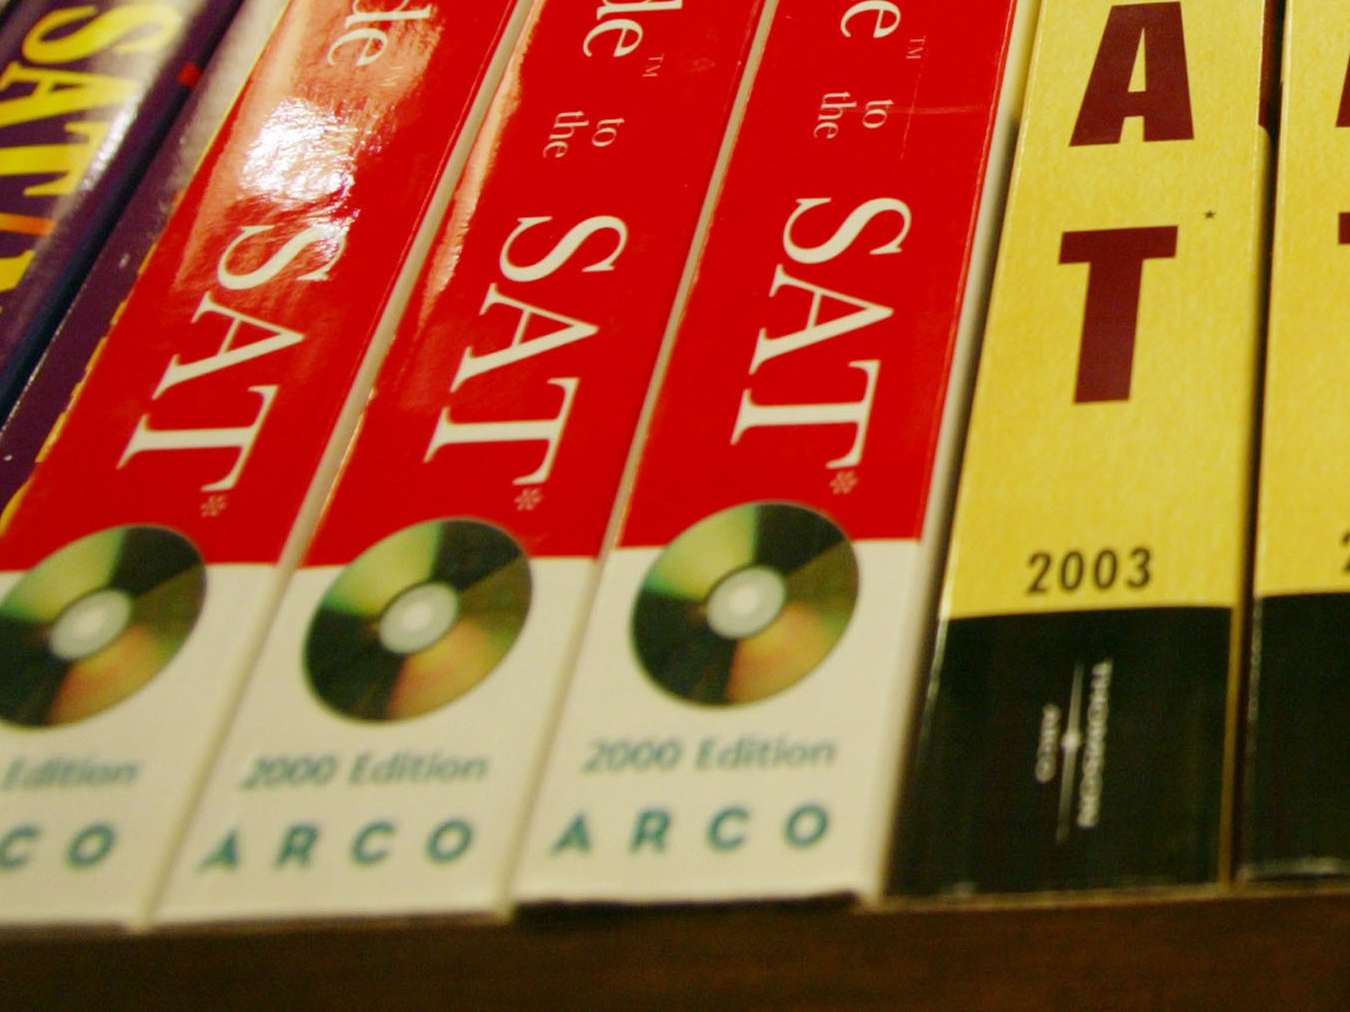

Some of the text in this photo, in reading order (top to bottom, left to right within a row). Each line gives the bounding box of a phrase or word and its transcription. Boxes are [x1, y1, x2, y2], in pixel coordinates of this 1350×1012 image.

[542, 110, 589, 158] the
[592, 116, 624, 148] to
[813, 91, 857, 139] the
[862, 98, 894, 128] to
[116, 221, 348, 492] SAT
[423, 215, 628, 486] SAT
[730, 196, 912, 470] SAT
[1026, 545, 1154, 593] 2003
[240, 748, 489, 791] 2000 Edition
[582, 734, 837, 775] 2000 Edition
[198, 817, 477, 872] ARCO
[550, 802, 832, 858] ARCO
